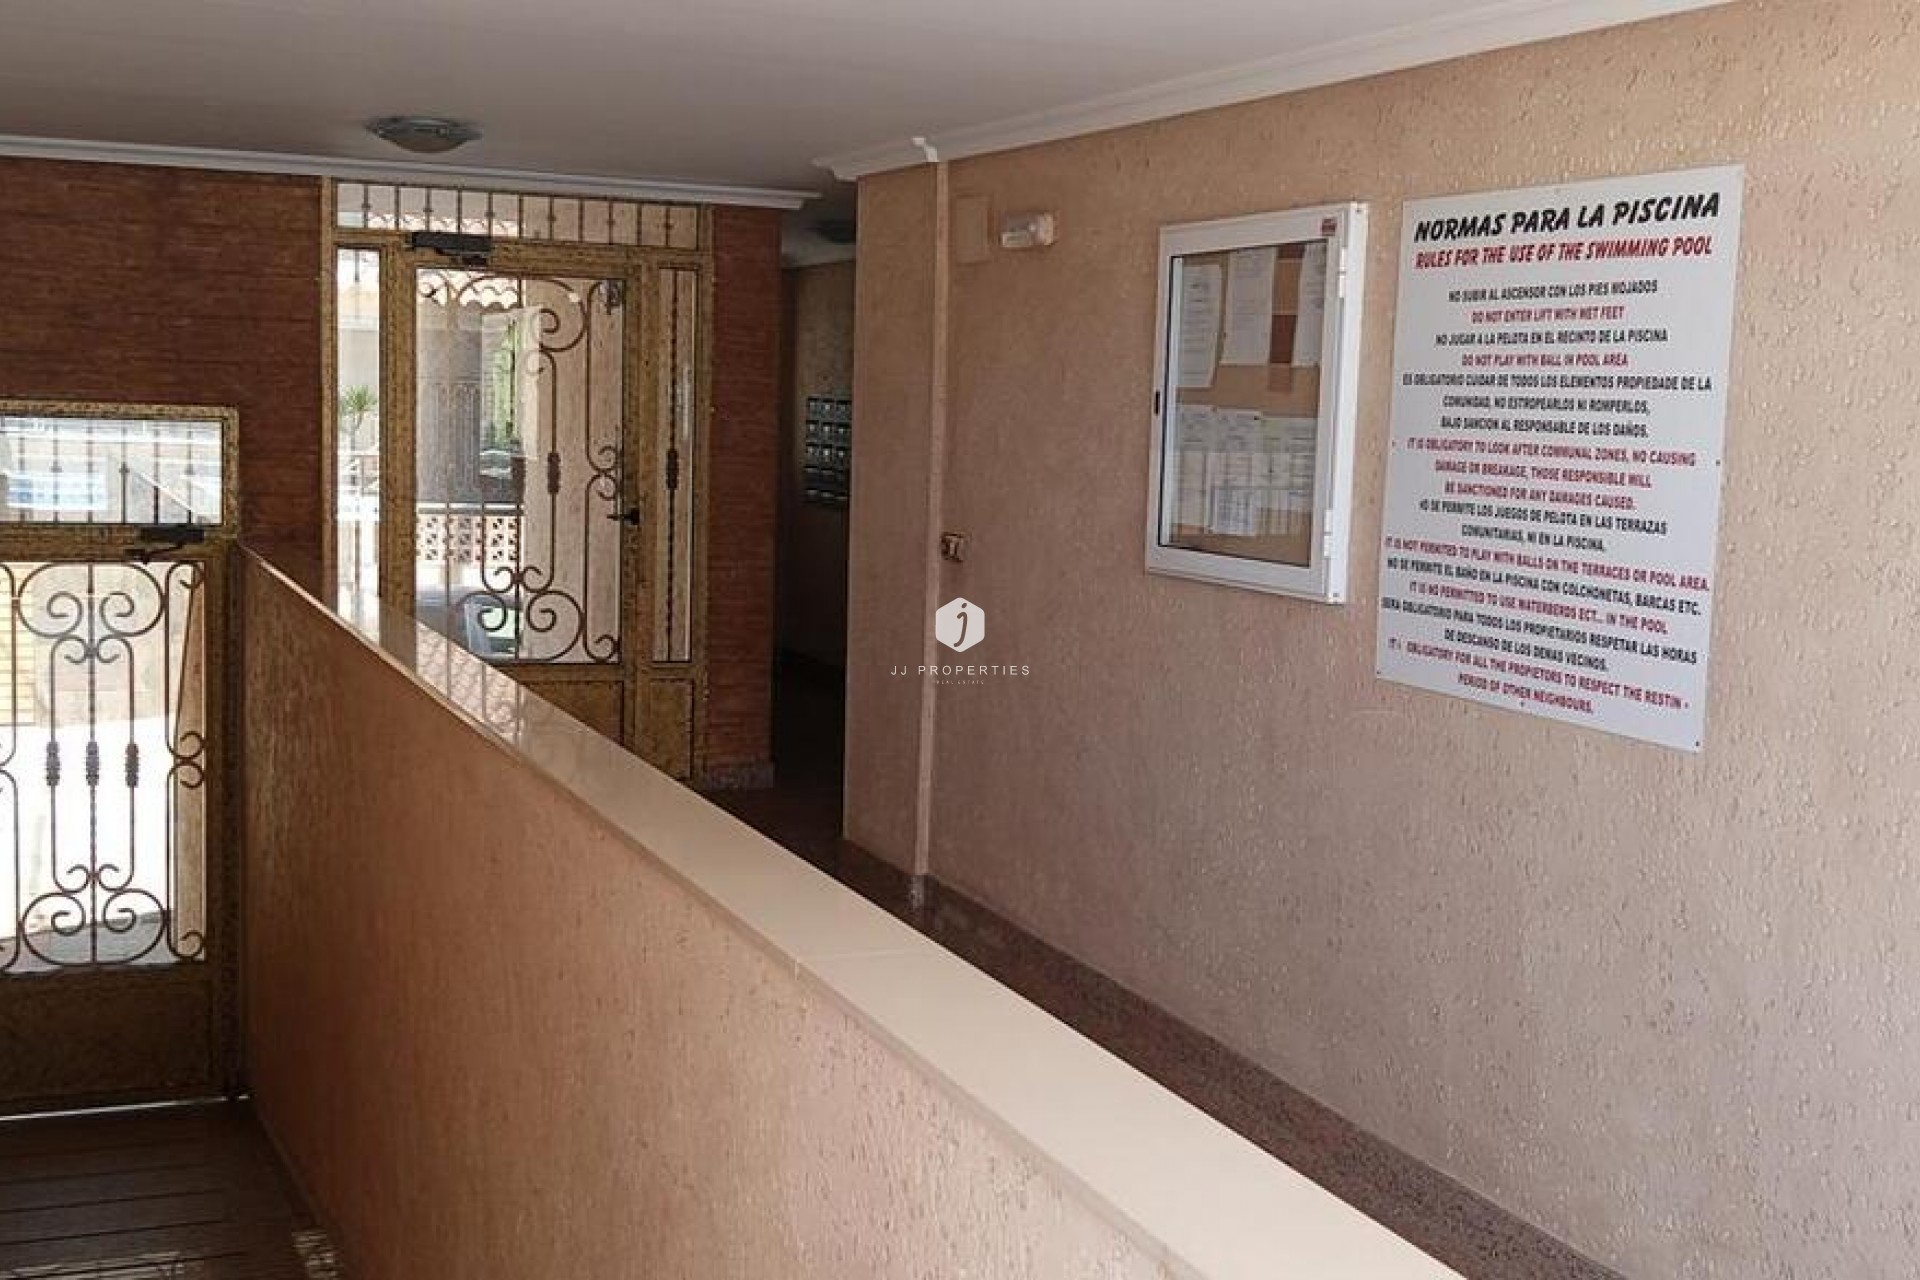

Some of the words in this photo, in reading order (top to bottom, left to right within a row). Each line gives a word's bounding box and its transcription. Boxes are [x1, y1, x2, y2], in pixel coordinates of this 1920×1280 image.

[1413, 212, 1506, 242] NORMAS
[1509, 207, 1569, 234] PARA
[1576, 203, 1604, 229] LA
[1611, 191, 1720, 226] PISCINA
[1415, 250, 1453, 268] RULES
[1453, 248, 1479, 266] FOR
[1482, 246, 1505, 265] THE
[1508, 244, 1534, 263] USE
[1536, 243, 1554, 261] OF
[1558, 241, 1583, 260] THE
[1586, 236, 1670, 259] SWIMMING
[1672, 234, 1713, 256] POOL
[1448, 290, 1460, 302] NO
[1461, 289, 1486, 301] SUBIR
[1487, 288, 1499, 300] AL
[1500, 286, 1545, 299] ASCENSOR
[1547, 284, 1566, 297] CON
[1568, 283, 1585, 296] LOS
[1588, 282, 1608, 295] PIES
[1611, 279, 1657, 294] MOJADOS
[1471, 311, 1483, 323] DO
[1485, 310, 1502, 323] NOT
[1503, 309, 1532, 322] ENTER
[1533, 308, 1552, 321] LIFT
[1553, 307, 1577, 320] WITH
[1578, 306, 1598, 319] WET
[1599, 306, 1624, 319] FEET
[1435, 334, 1447, 345] NO
[1448, 333, 1475, 345] JUGAR
[1483, 333, 1495, 344] LA
[1496, 332, 1528, 344] PELOTA
[1530, 331, 1542, 343] EN
[1543, 331, 1555, 343] EL
[1556, 330, 1595, 343] RECINTO
[1598, 330, 1611, 342] DE
[1612, 330, 1625, 342] LA
[1627, 329, 1668, 342] PISCINA
[1461, 354, 1473, 365] DO
[1474, 354, 1493, 365] NOT
[1494, 354, 1515, 365] PLAY
[1516, 354, 1539, 365] WITH
[1540, 354, 1561, 365] BALL
[1575, 354, 1600, 365] POOL
[1601, 354, 1628, 365] AREA
[1413, 373, 1464, 385] OBLIGATORIO
[1466, 374, 1495, 386] CUIDAR
[1496, 374, 1509, 386] DE
[1510, 374, 1539, 387] TODOS
[1540, 375, 1556, 387] LOS
[1559, 375, 1614, 388] ELEMENTOS
[1616, 375, 1678, 389] PROPIEDADE
[1679, 376, 1695, 389] DE
[1697, 376, 1712, 390] LA
[1493, 396, 1506, 408] NO
[1507, 397, 1573, 410] ESTROPEARLOS
[1441, 416, 1461, 428] BAJO
[1512, 419, 1575, 433] RESPONSABLE
[1576, 421, 1590, 434] DE
[1592, 422, 1611, 435] LOS
[1425, 438, 1473, 452] OBLIGATORY
[1474, 441, 1486, 453] TO
[1487, 442, 1509, 454] LOOK
[1510, 443, 1539, 456] AFTER
[1541, 444, 1591, 459] COMMUNAL
[1632, 450, 1647, 463] NO
[1648, 450, 1696, 466] CAUSING
[1435, 459, 1467, 473] DAMAGE
[1468, 462, 1480, 474] OR
[1530, 466, 1559, 480] THOSE
[1561, 468, 1625, 485] RESPONSIBLE
[1626, 473, 1652, 488] WILL
[1456, 482, 1507, 498] SANCTIONED
[1508, 487, 1527, 499] FOR
[1529, 488, 1545, 501] ANY
[1548, 490, 1591, 506] DAMAGES
[1595, 494, 1635, 510] CAUSED.
[1440, 501, 1475, 515] PERMITE
[1476, 504, 1493, 517] LOS
[1495, 506, 1528, 520] JUEGOS
[1529, 509, 1541, 522] DE
[1543, 510, 1577, 525] PELOTA
[1578, 513, 1592, 527] EN
[1594, 515, 1612, 529] LAS
[1614, 517, 1667, 535] TERRAZAS
[1538, 532, 1550, 545] EN
[1402, 538, 1418, 551] NOT
[1471, 547, 1492, 561] PLAY
[1493, 550, 1515, 565] WITH
[1516, 553, 1543, 568] BALLS
[1545, 557, 1559, 570] ON
[1560, 559, 1579, 573] THE
[1581, 561, 1629, 580] TERRACES
[1631, 568, 1647, 582] OR
[1648, 570, 1677, 586] POOL
[1410, 560, 1443, 575] PERMITE
[1443, 564, 1453, 577] EL
[1479, 569, 1491, 582] EN
[1492, 571, 1504, 584] LA
[1505, 573, 1539, 590] PISCINA
[1540, 578, 1560, 593] CON
[1635, 593, 1675, 611] BARCAS
[1677, 599, 1701, 616] ETC.
[1409, 581, 1416, 592] IT
[1418, 582, 1425, 593] IS
[1428, 584, 1439, 596] NO
[1486, 593, 1497, 605] TO
[1499, 595, 1516, 609] USE
[1605, 612, 1616, 625] IN
[1618, 614, 1638, 629] THE
[1402, 600, 1452, 620] OBLIGATORIO
[1452, 609, 1474, 624] PARA
[1476, 613, 1503, 629] TODOS
[1504, 618, 1522, 632] LOS
[1523, 621, 1587, 644] PROPIETARIOS
[1589, 633, 1639, 653] RESPETAR
[1640, 642, 1660, 657] LAS
[1661, 645, 1697, 664] HORAS
[1444, 628, 1454, 641] DE
[1456, 630, 1499, 650] DESCANSO
[1500, 639, 1512, 652] DE
[1513, 641, 1531, 656] LOS
[1387, 638, 1396, 649] IT
[1406, 641, 1454, 661] OBLIGATORY
[1455, 651, 1472, 665] FOR
[1473, 655, 1488, 668] ALL
[1489, 658, 1507, 672] THE
[1564, 673, 1576, 687] TO
[1578, 676, 1620, 696] RESPECT
[1622, 685, 1642, 701] THE
[1458, 672, 1488, 690] PERIOD
[1489, 679, 1501, 692] OF
[1502, 682, 1530, 699] OTHER
